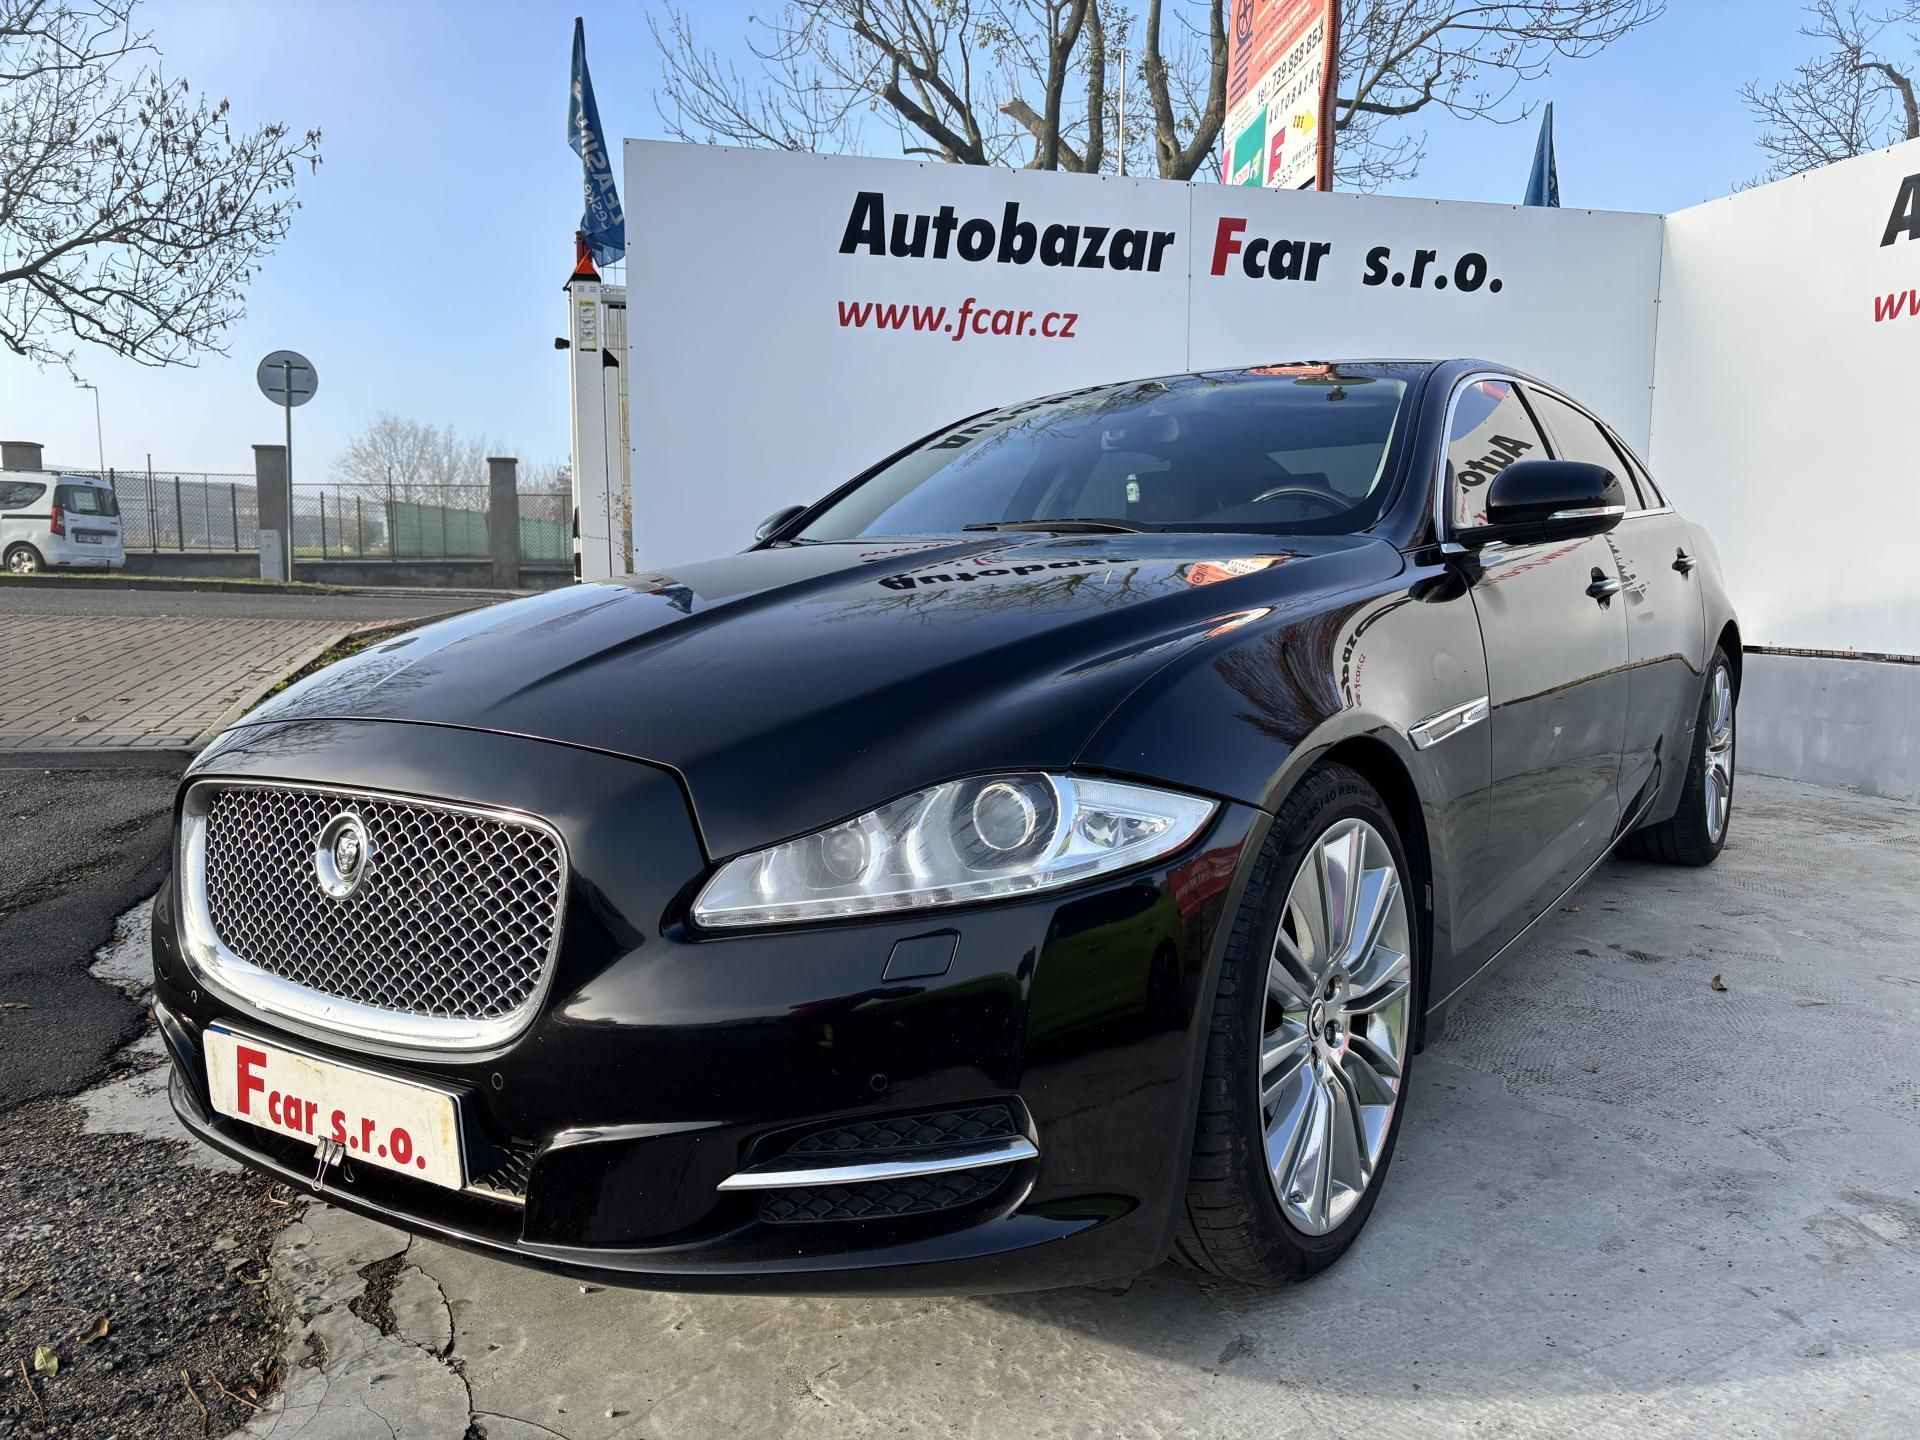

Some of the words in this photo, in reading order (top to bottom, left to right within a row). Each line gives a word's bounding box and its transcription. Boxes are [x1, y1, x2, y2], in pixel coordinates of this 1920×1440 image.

[839, 191, 1176, 273] Autobazar
[1211, 217, 1331, 282] Fcar
[1362, 245, 1504, 293] s.r.o.
[838, 298, 1079, 342] www.fcar.cz
[236, 1045, 318, 1136] Fcar
[331, 1109, 427, 1170] s.r.o.
